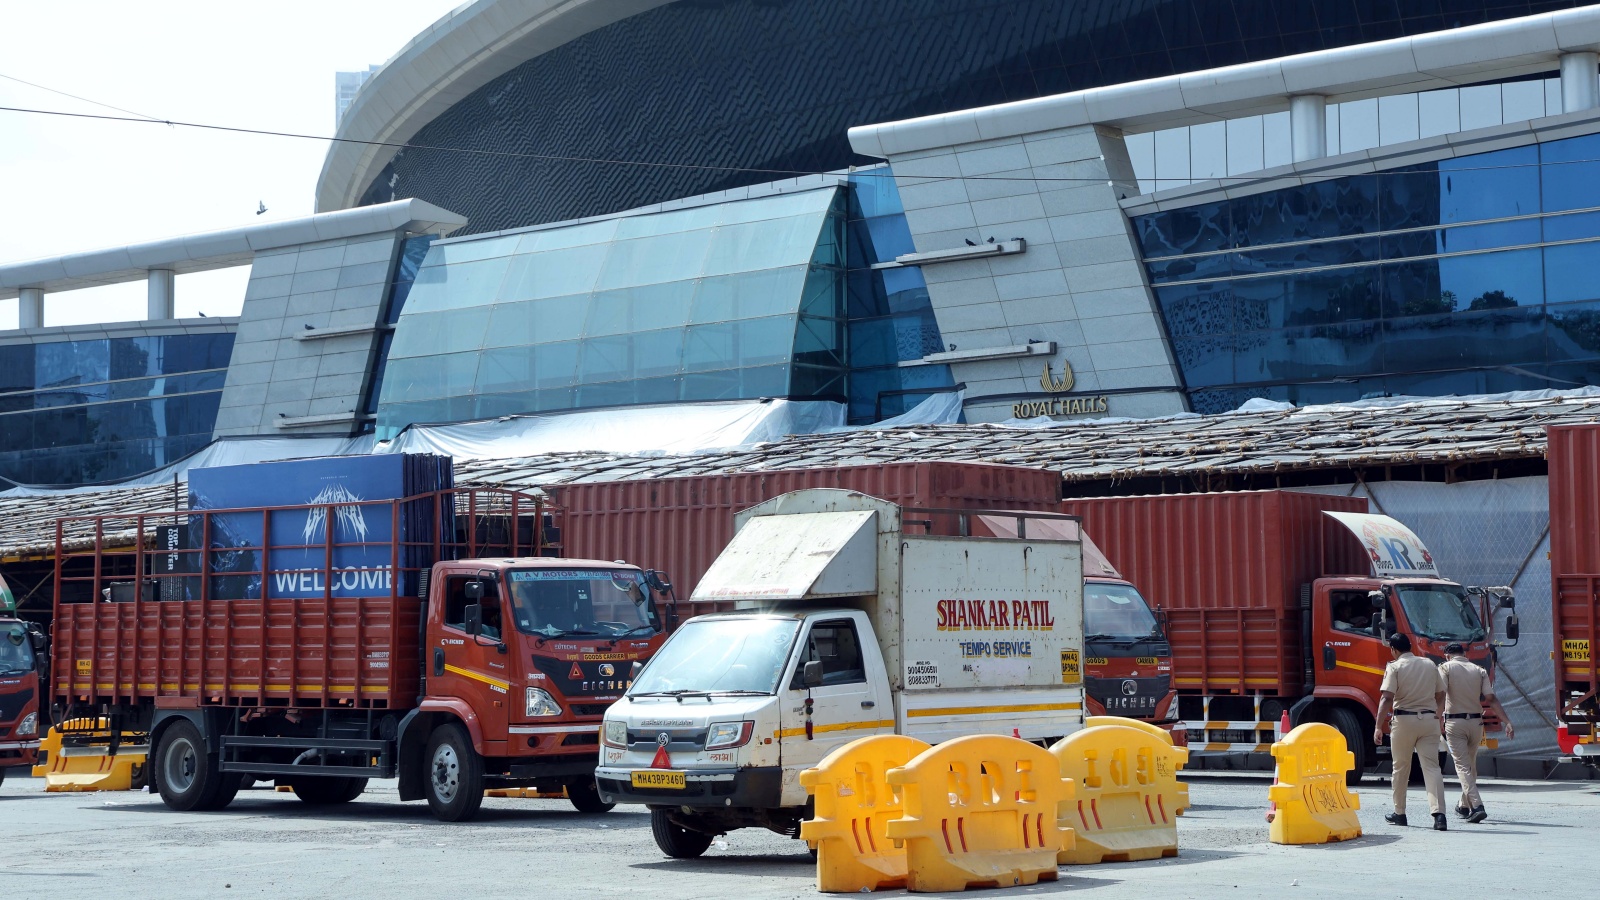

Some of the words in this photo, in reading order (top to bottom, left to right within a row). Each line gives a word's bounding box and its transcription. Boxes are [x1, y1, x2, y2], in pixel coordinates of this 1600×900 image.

[1012, 401, 1056, 418] ROYAL
[1060, 396, 1107, 415] HALLS
[274, 564, 399, 593] WELCOME
[936, 599, 1010, 632] SHANKAR
[1012, 599, 1055, 631] PATIL
[959, 641, 991, 658] TEMPO
[992, 641, 1032, 658] SERVICE
[582, 680, 633, 691] EICHER
[1106, 697, 1156, 709] EICHER
[637, 773, 684, 785] MH43BP3460
